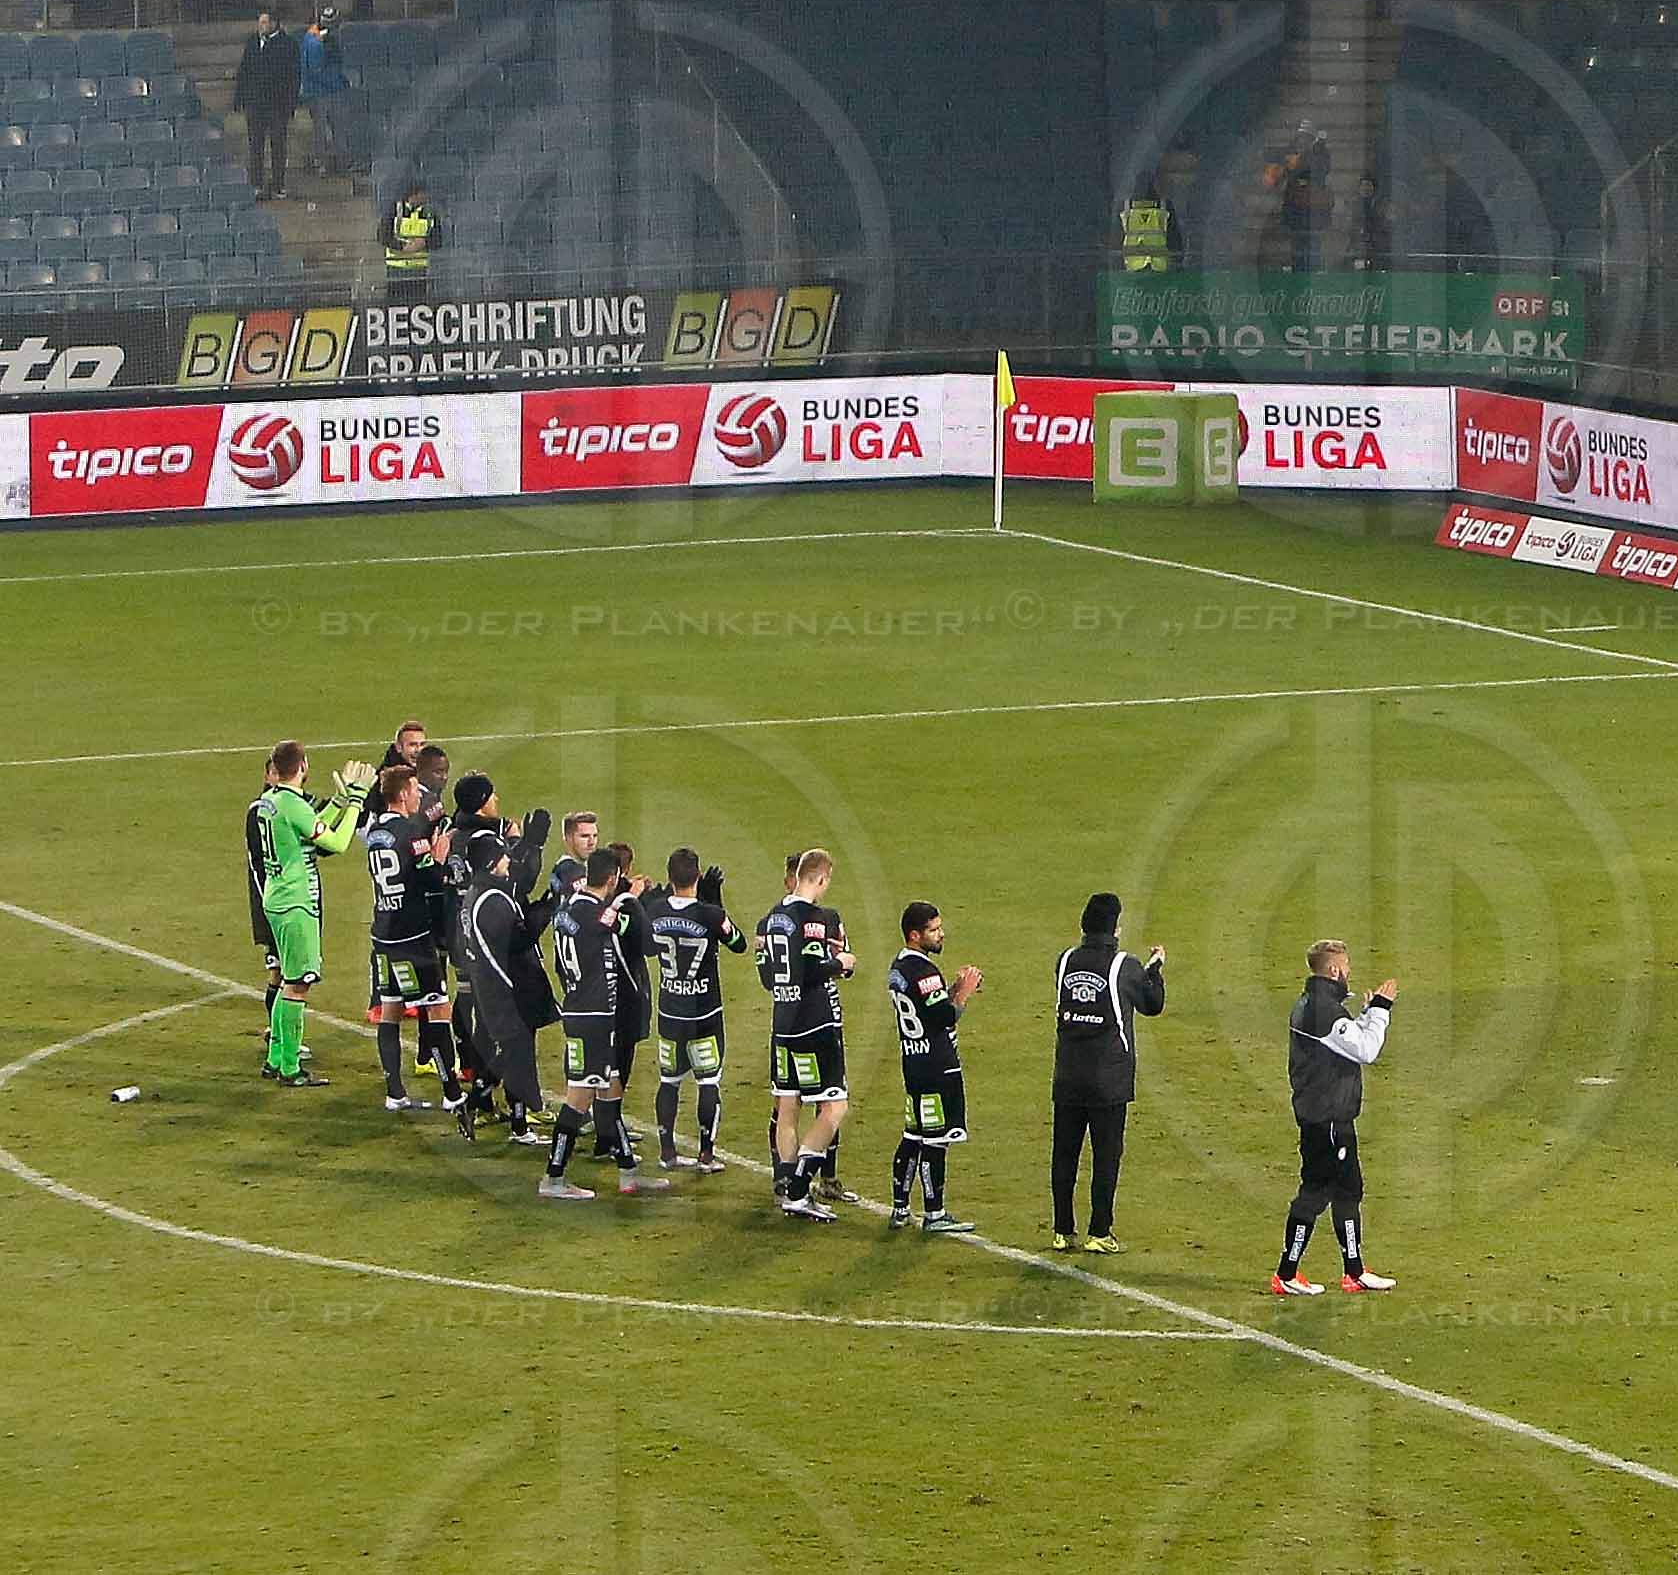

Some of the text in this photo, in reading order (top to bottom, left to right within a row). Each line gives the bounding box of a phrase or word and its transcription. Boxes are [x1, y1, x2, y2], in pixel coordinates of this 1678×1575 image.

[366, 294, 647, 345] BESCHRIFTUNG
[1497, 296, 1545, 316] ORF
[1110, 324, 1568, 360] RADIO STEIERMARK
[803, 395, 920, 421] BUNDES
[1010, 404, 1094, 450] tipi
[1264, 405, 1382, 429] BUNDES
[319, 416, 442, 442] BUNDES
[538, 417, 680, 456] tipico
[803, 421, 924, 463] LIGA
[1464, 418, 1530, 466] tipico
[1588, 430, 1648, 461] BUNDES
[47, 440, 193, 485] tipico
[319, 442, 445, 484] LIGA
[1265, 429, 1387, 471] LIGA
[1588, 457, 1653, 505] LIGA
[1449, 509, 1516, 549] tipico
[1526, 530, 1557, 549] tipico
[1570, 541, 1599, 563] LIGA
[1611, 536, 1678, 578] tipico
[652, 933, 709, 980] 37
